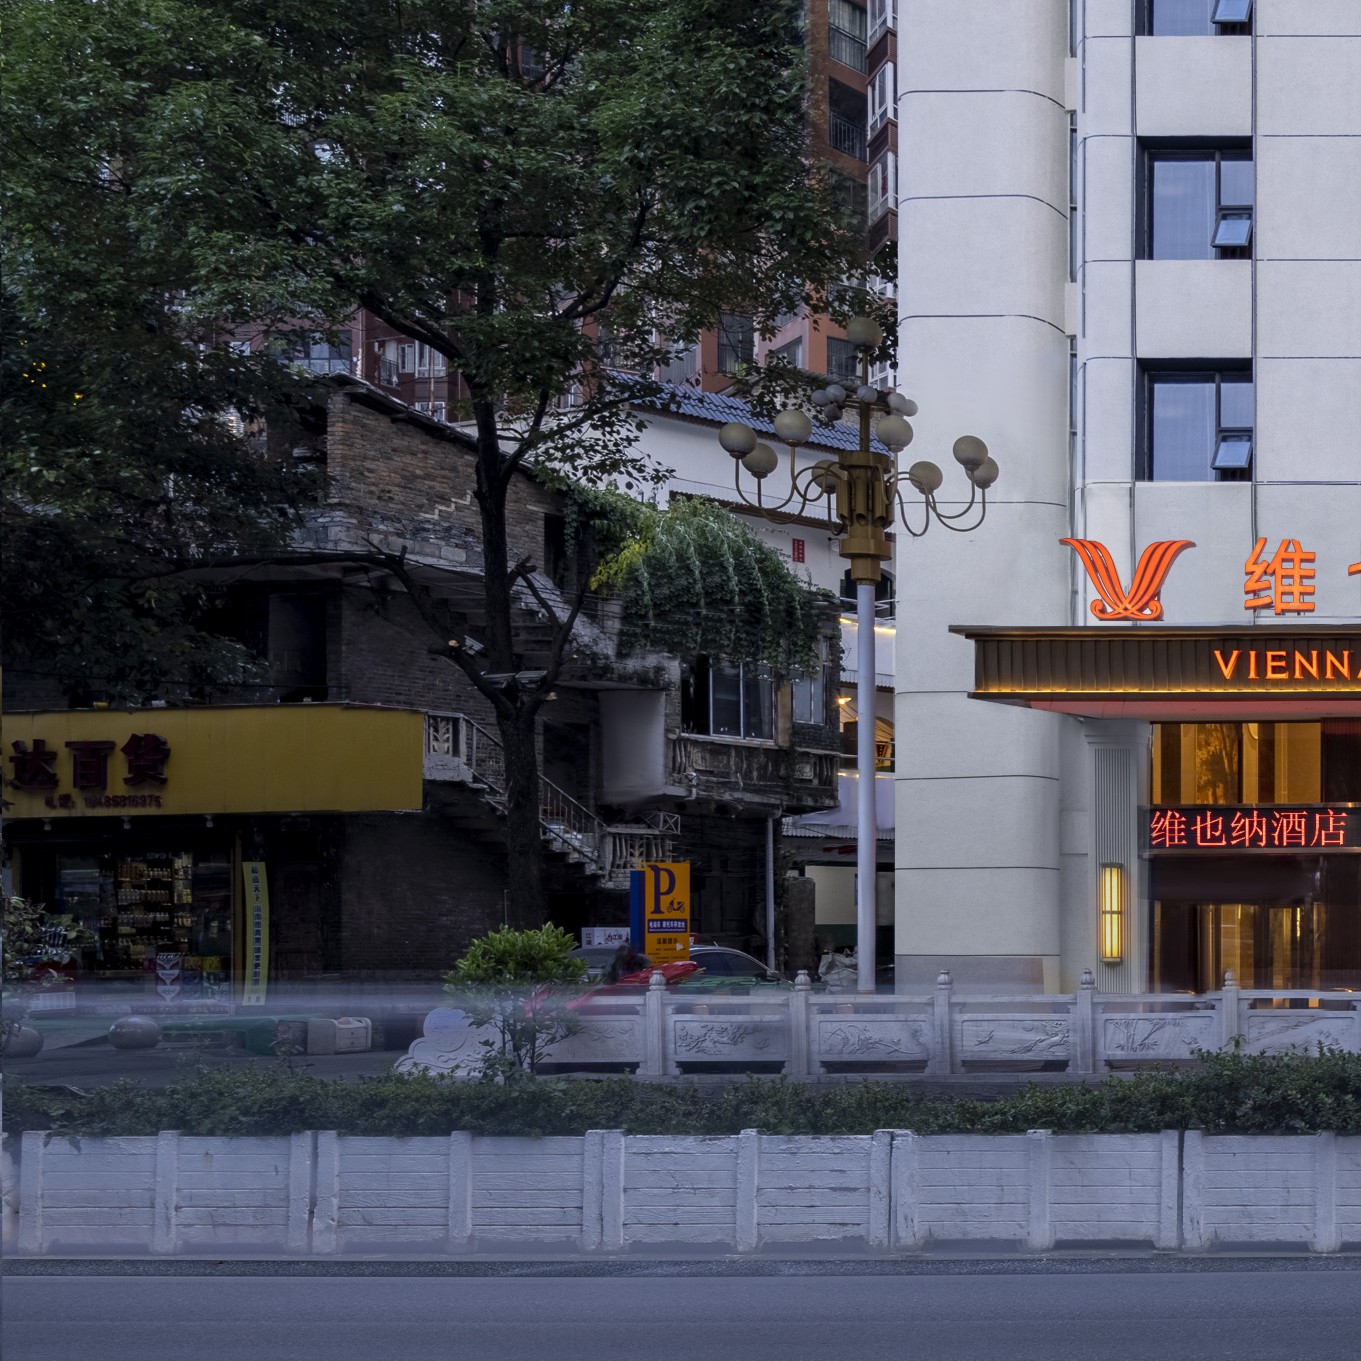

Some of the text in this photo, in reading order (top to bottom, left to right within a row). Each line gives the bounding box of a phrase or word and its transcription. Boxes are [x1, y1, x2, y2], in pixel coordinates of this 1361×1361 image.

[9, 733, 171, 790] 达百货
[647, 864, 676, 914] P
